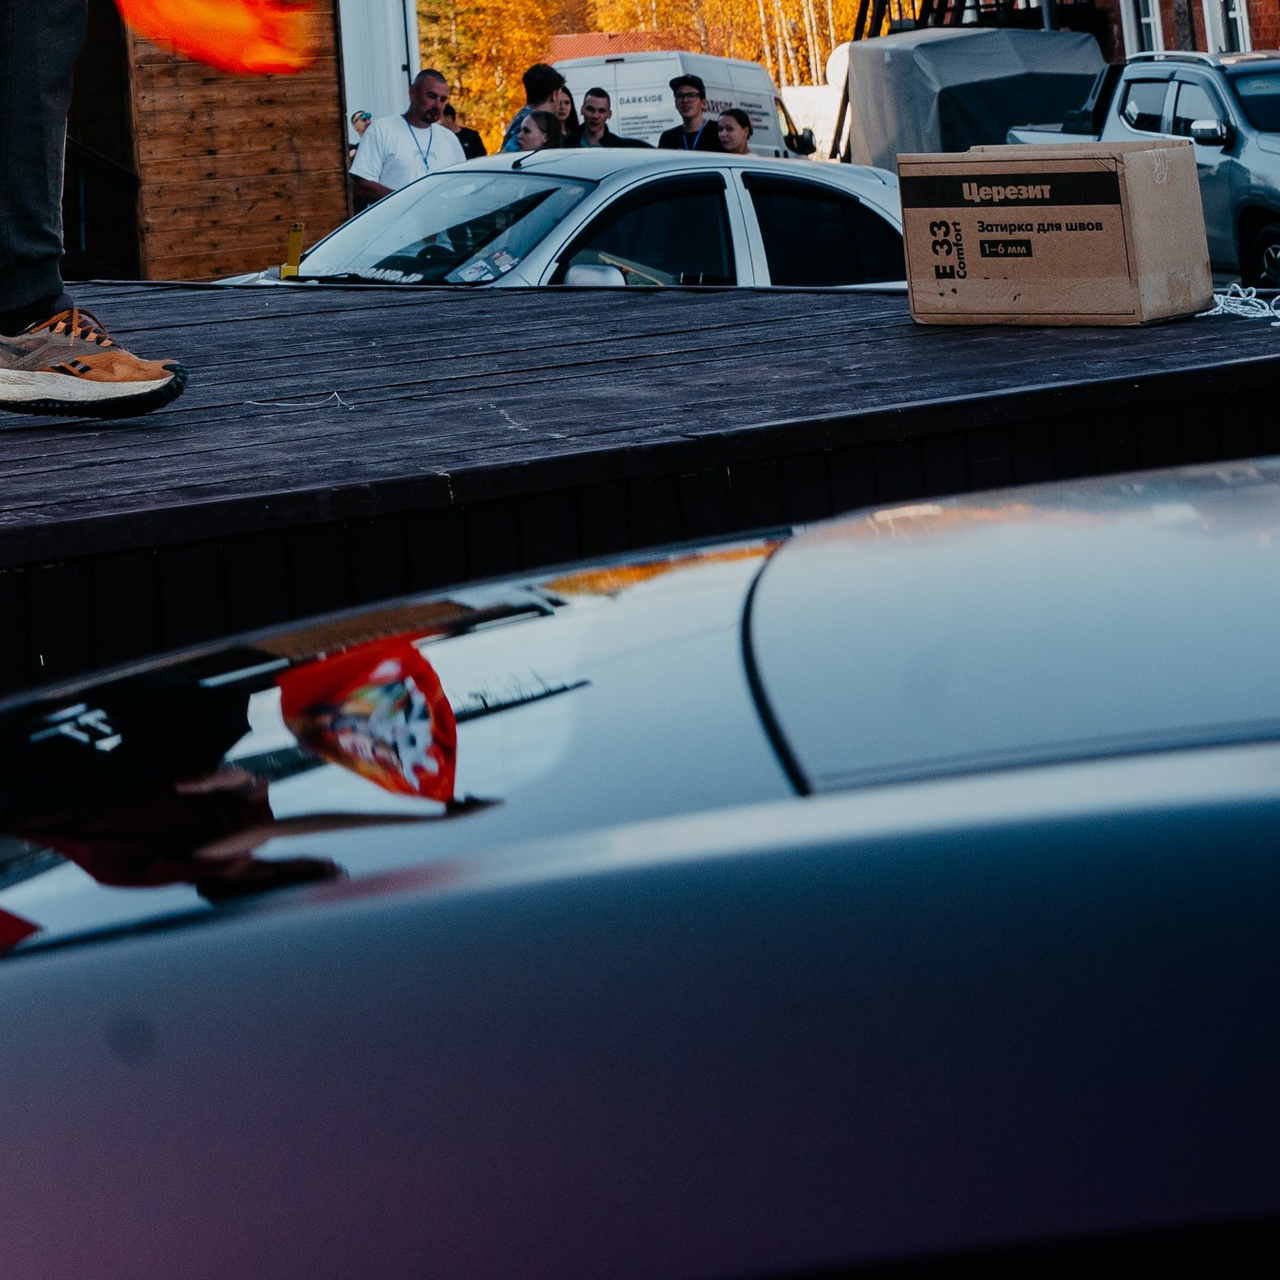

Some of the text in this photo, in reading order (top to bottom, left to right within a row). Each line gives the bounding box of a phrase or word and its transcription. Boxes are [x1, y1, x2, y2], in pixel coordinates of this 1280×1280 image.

[620, 94, 663, 105] DARKSIDE
[962, 182, 1051, 203] Церезит
[977, 220, 1104, 234] Затирка для швов
[951, 221, 968, 280] Comfort
[1007, 245, 1028, 254] мм
